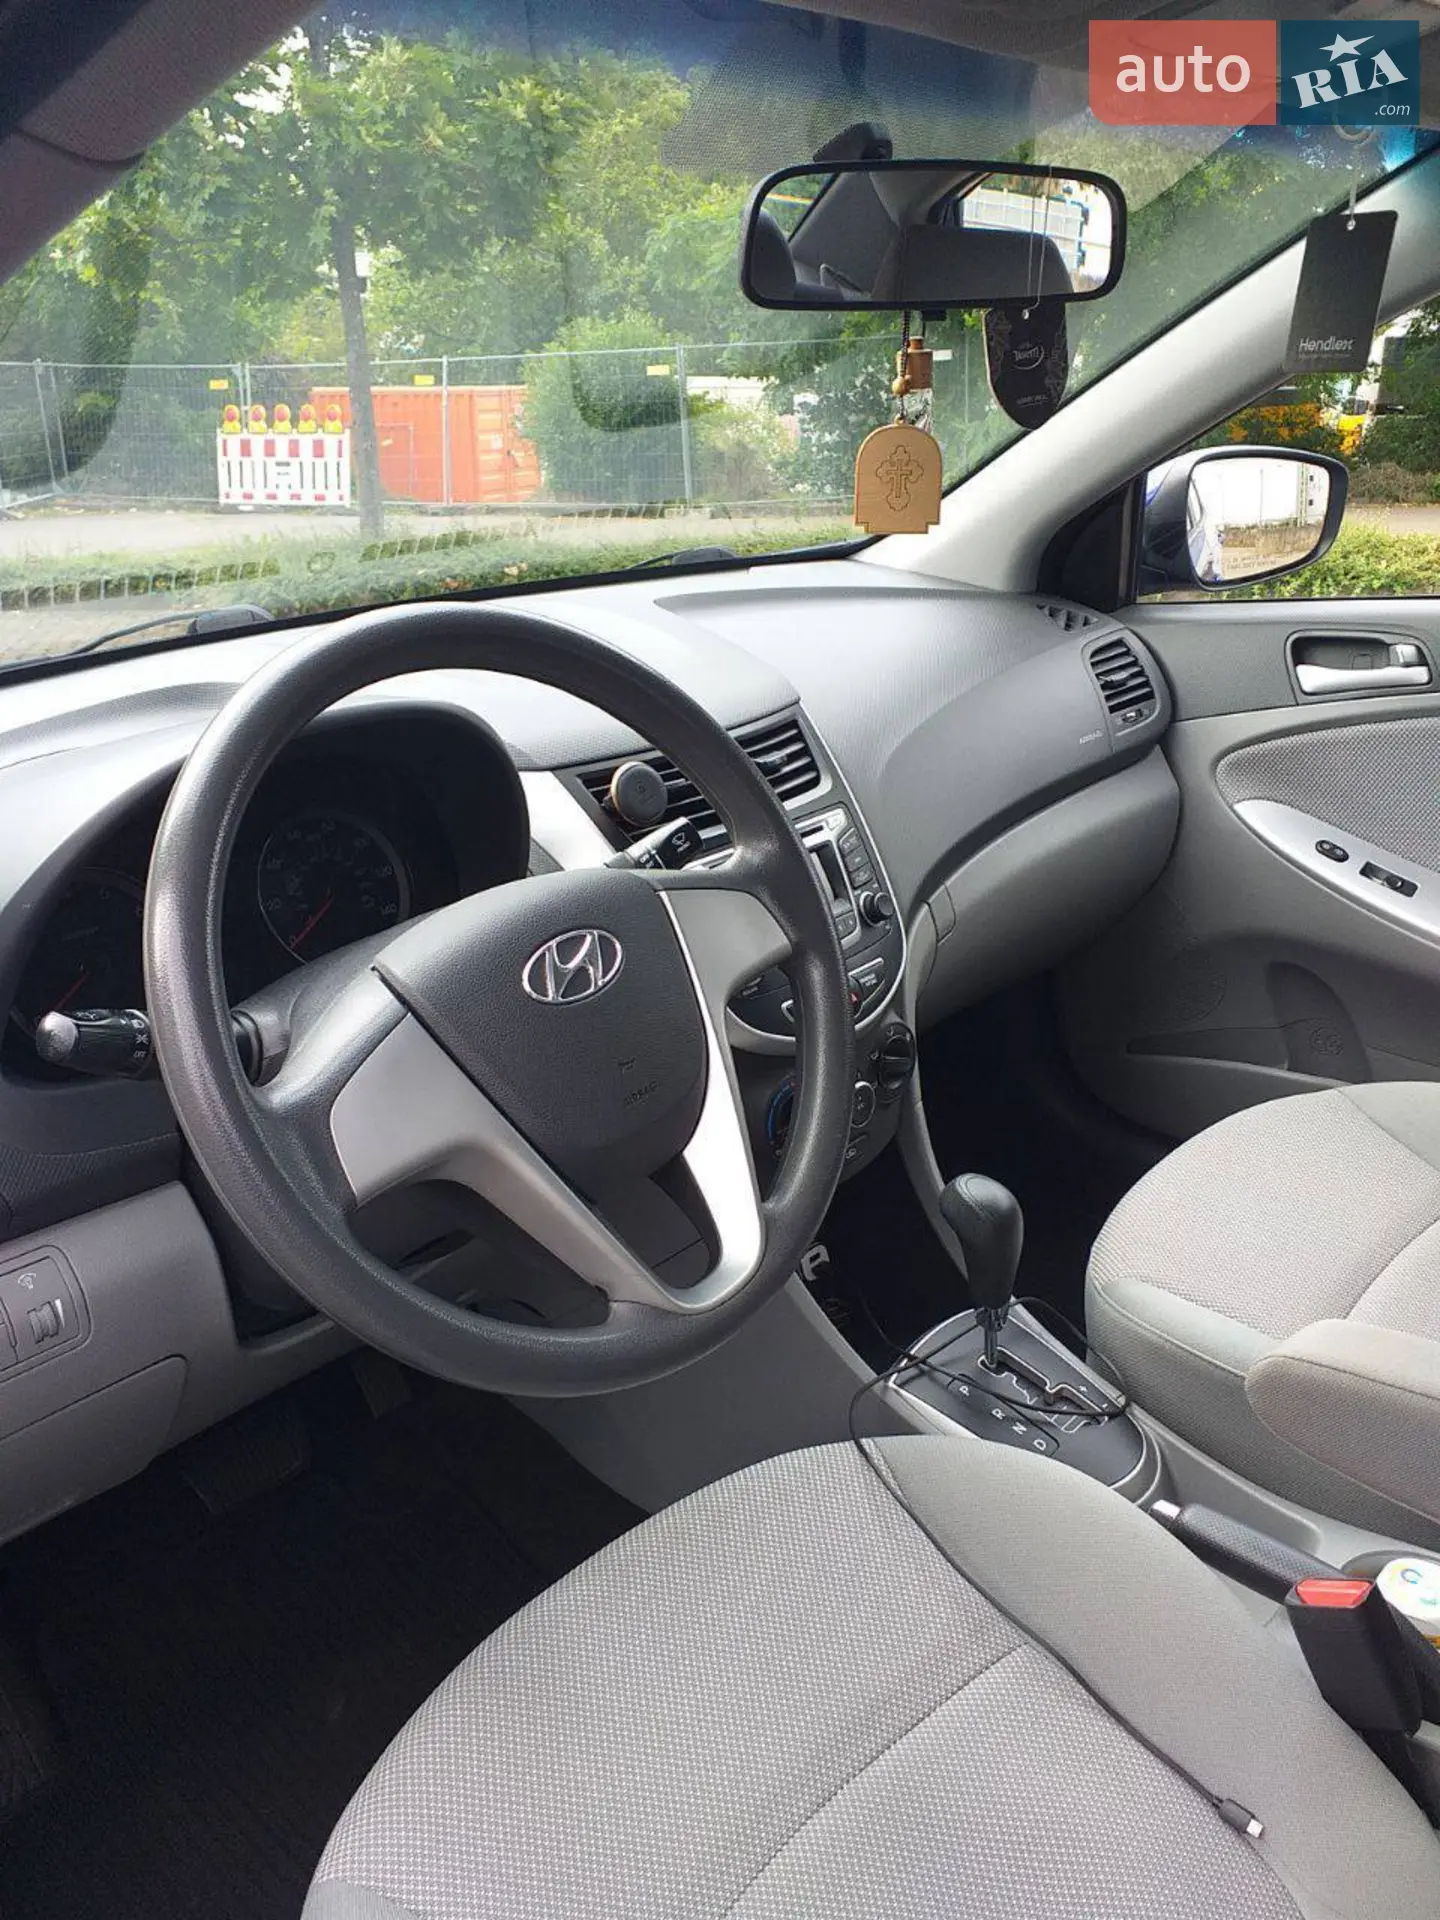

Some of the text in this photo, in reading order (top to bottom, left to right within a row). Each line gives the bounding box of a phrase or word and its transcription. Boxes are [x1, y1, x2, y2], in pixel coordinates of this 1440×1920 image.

[959, 1385, 969, 1397] P
[991, 1408, 1006, 1420] R
[1012, 1422, 1027, 1434] N
[1032, 1438, 1046, 1451] D
